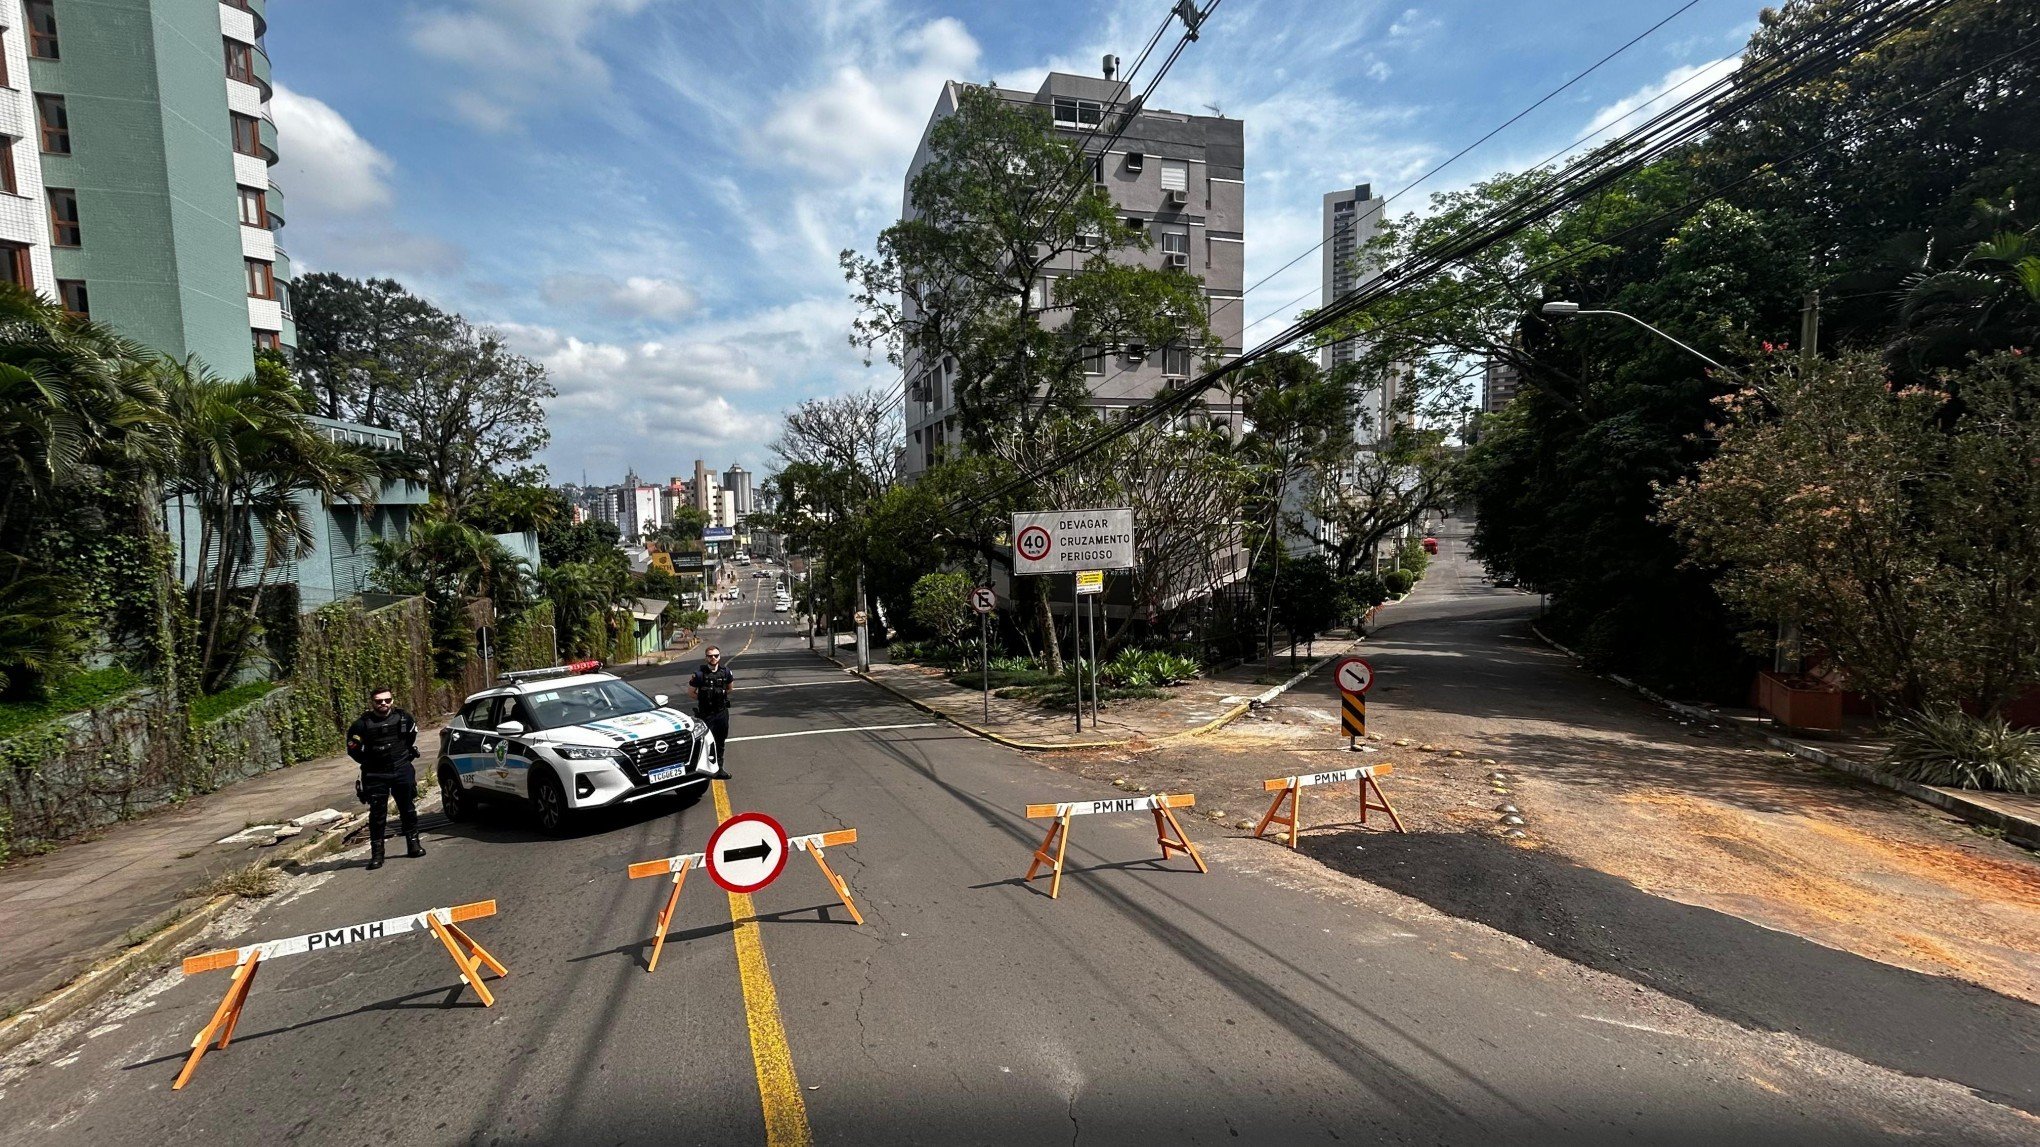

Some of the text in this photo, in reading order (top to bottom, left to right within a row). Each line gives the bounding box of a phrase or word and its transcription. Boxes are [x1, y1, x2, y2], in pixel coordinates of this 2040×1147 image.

[1060, 519, 1108, 530] DEVAGAR
[1024, 535, 1044, 548] 40
[1060, 534, 1130, 546] CRUZAMENTO
[1060, 549, 1113, 561] PERIGOSO
[1314, 771, 1347, 785] PMNH
[1093, 799, 1134, 814] PMNH
[308, 922, 384, 951] PMNH
